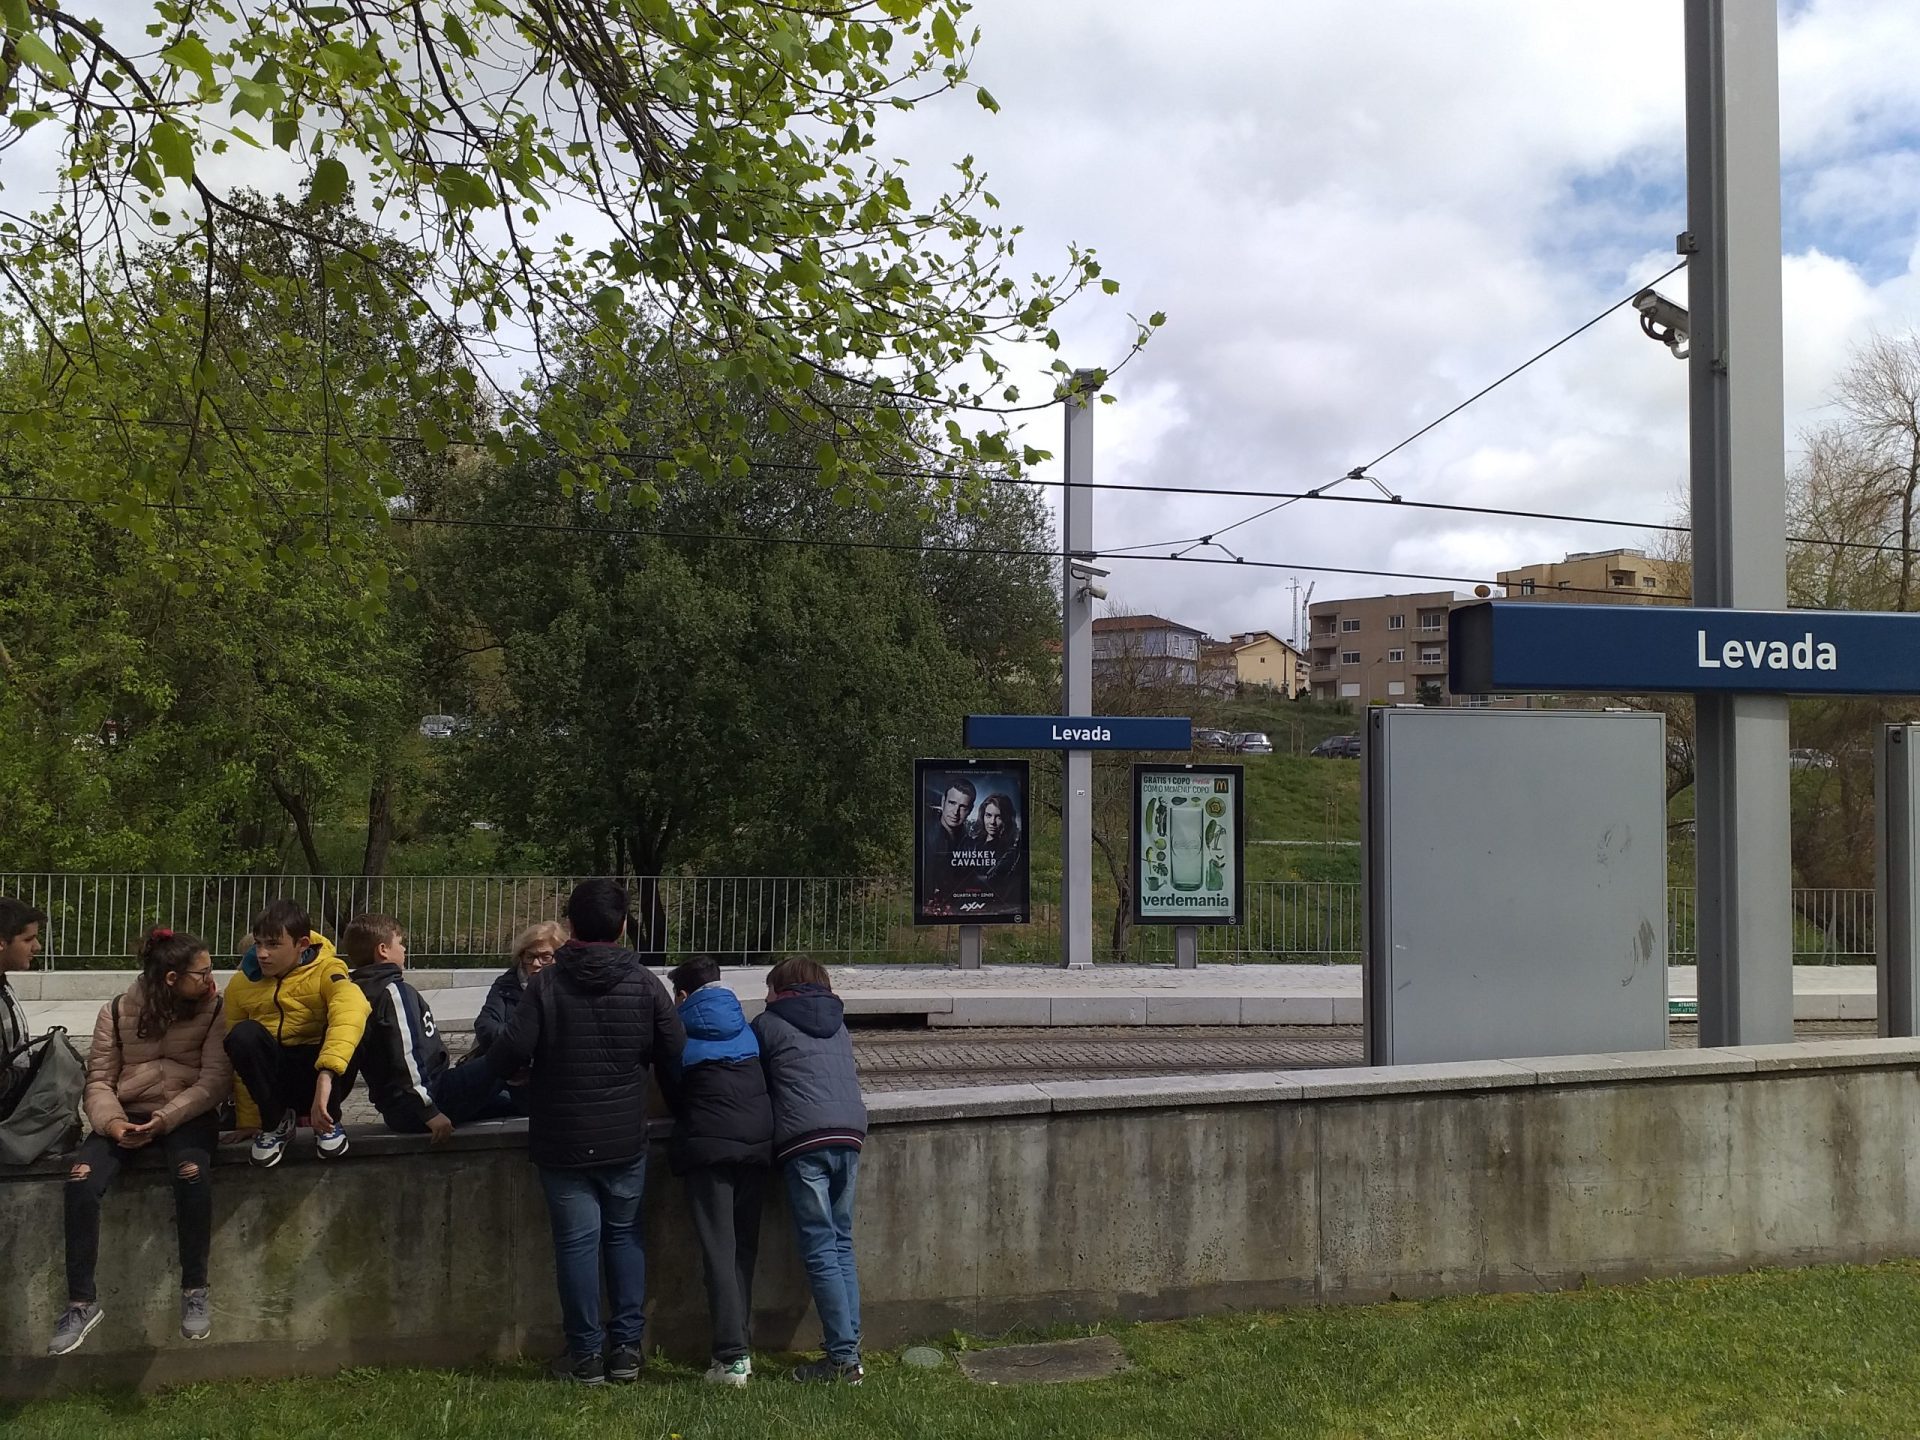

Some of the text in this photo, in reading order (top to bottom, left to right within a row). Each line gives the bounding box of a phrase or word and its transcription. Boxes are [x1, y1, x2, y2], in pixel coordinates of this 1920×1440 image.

[1697, 630, 1837, 671] Levada
[1052, 725, 1111, 741] Levada
[1143, 776, 1167, 784] GRATIS
[1172, 777, 1191, 785] COPO
[1192, 786, 1210, 794] COPO
[952, 850, 996, 859] WHISKEY
[950, 858, 997, 867] CAVALIER
[1142, 893, 1229, 907] verdemania
[959, 901, 986, 912] AXN
